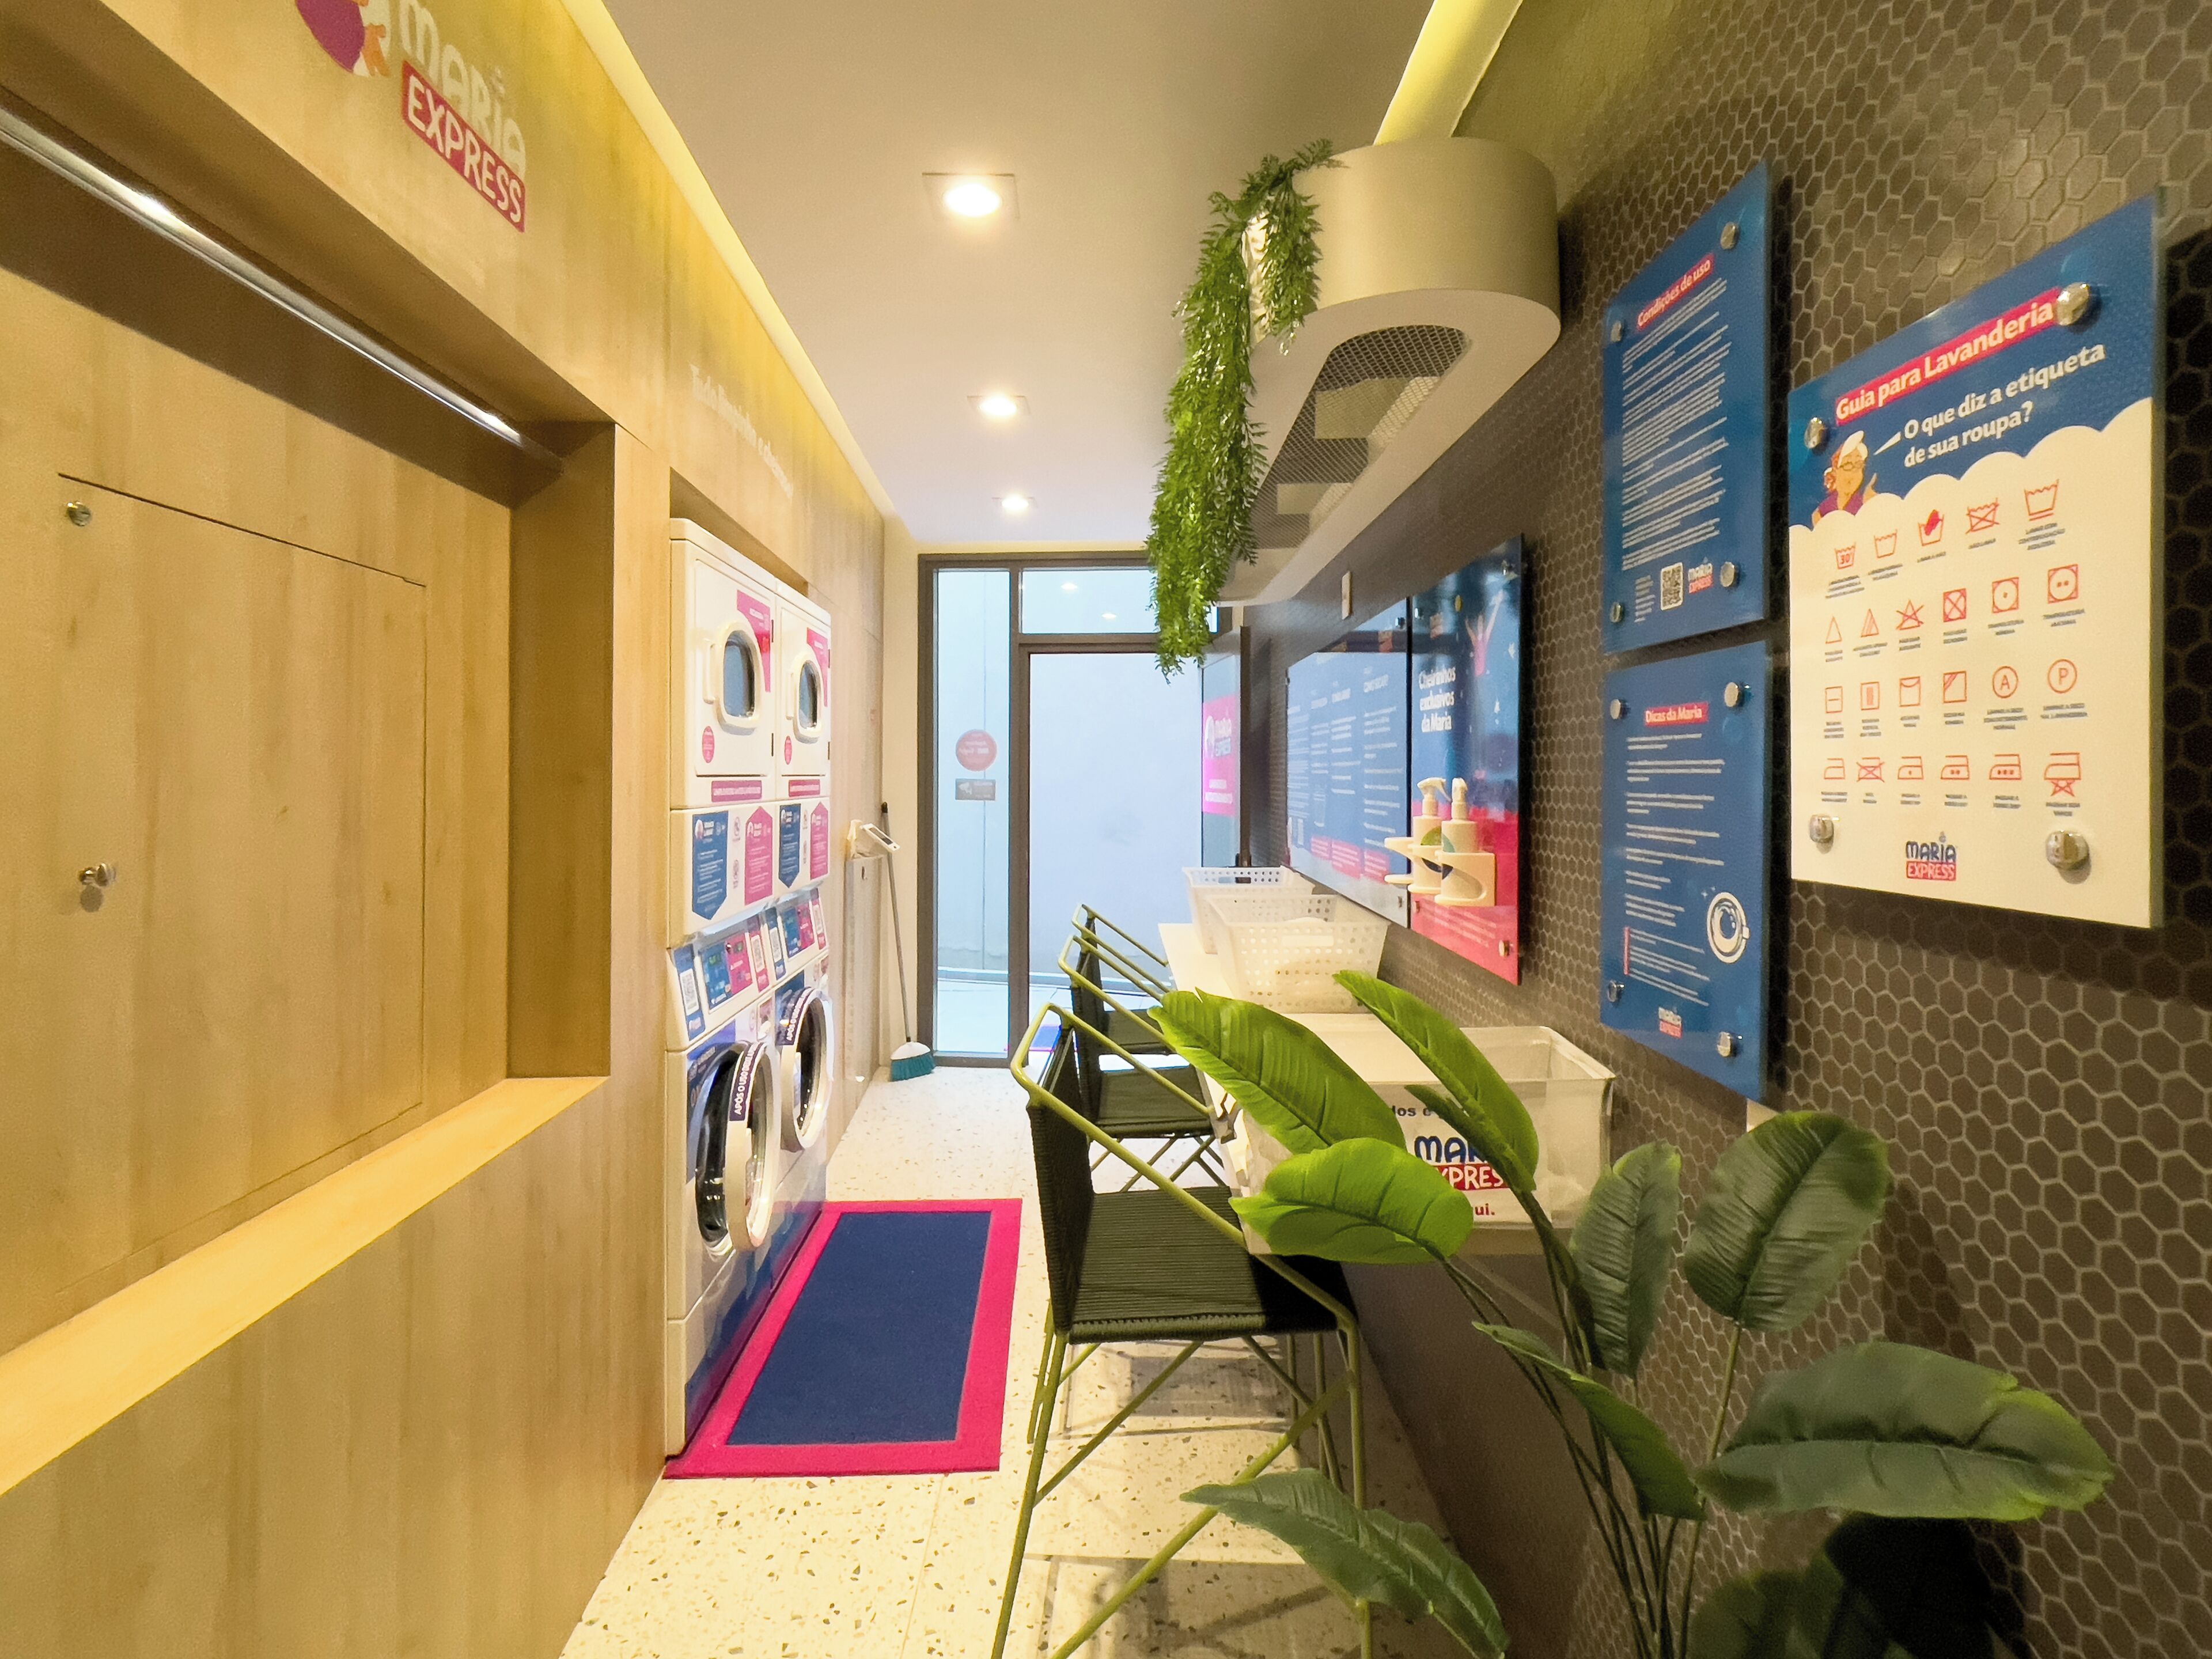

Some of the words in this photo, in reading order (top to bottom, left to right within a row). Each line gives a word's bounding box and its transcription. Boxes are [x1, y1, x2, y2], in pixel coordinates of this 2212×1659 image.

[399, 0, 526, 183] MARIA
[407, 74, 522, 223] EXPRESS
[1680, 274, 1692, 291] de
[1694, 260, 1711, 281] uso
[1836, 389, 1876, 420] Guia
[1878, 368, 1922, 407] para
[1924, 302, 2054, 378] Lavanderia
[1904, 419, 1919, 440] O
[1921, 407, 1955, 435] que
[1958, 392, 1987, 418] diz
[1989, 388, 2003, 405] a
[2005, 344, 2106, 398] etiqueta
[1904, 446, 1926, 468] de
[1927, 434, 1960, 460] sua
[1962, 400, 2034, 447] roupa?
[1646, 710, 1666, 723] Dicas
[1677, 706, 1703, 720] Maria
[1905, 840, 1957, 863] MARIA
[1907, 863, 1956, 880] EXPRESS
